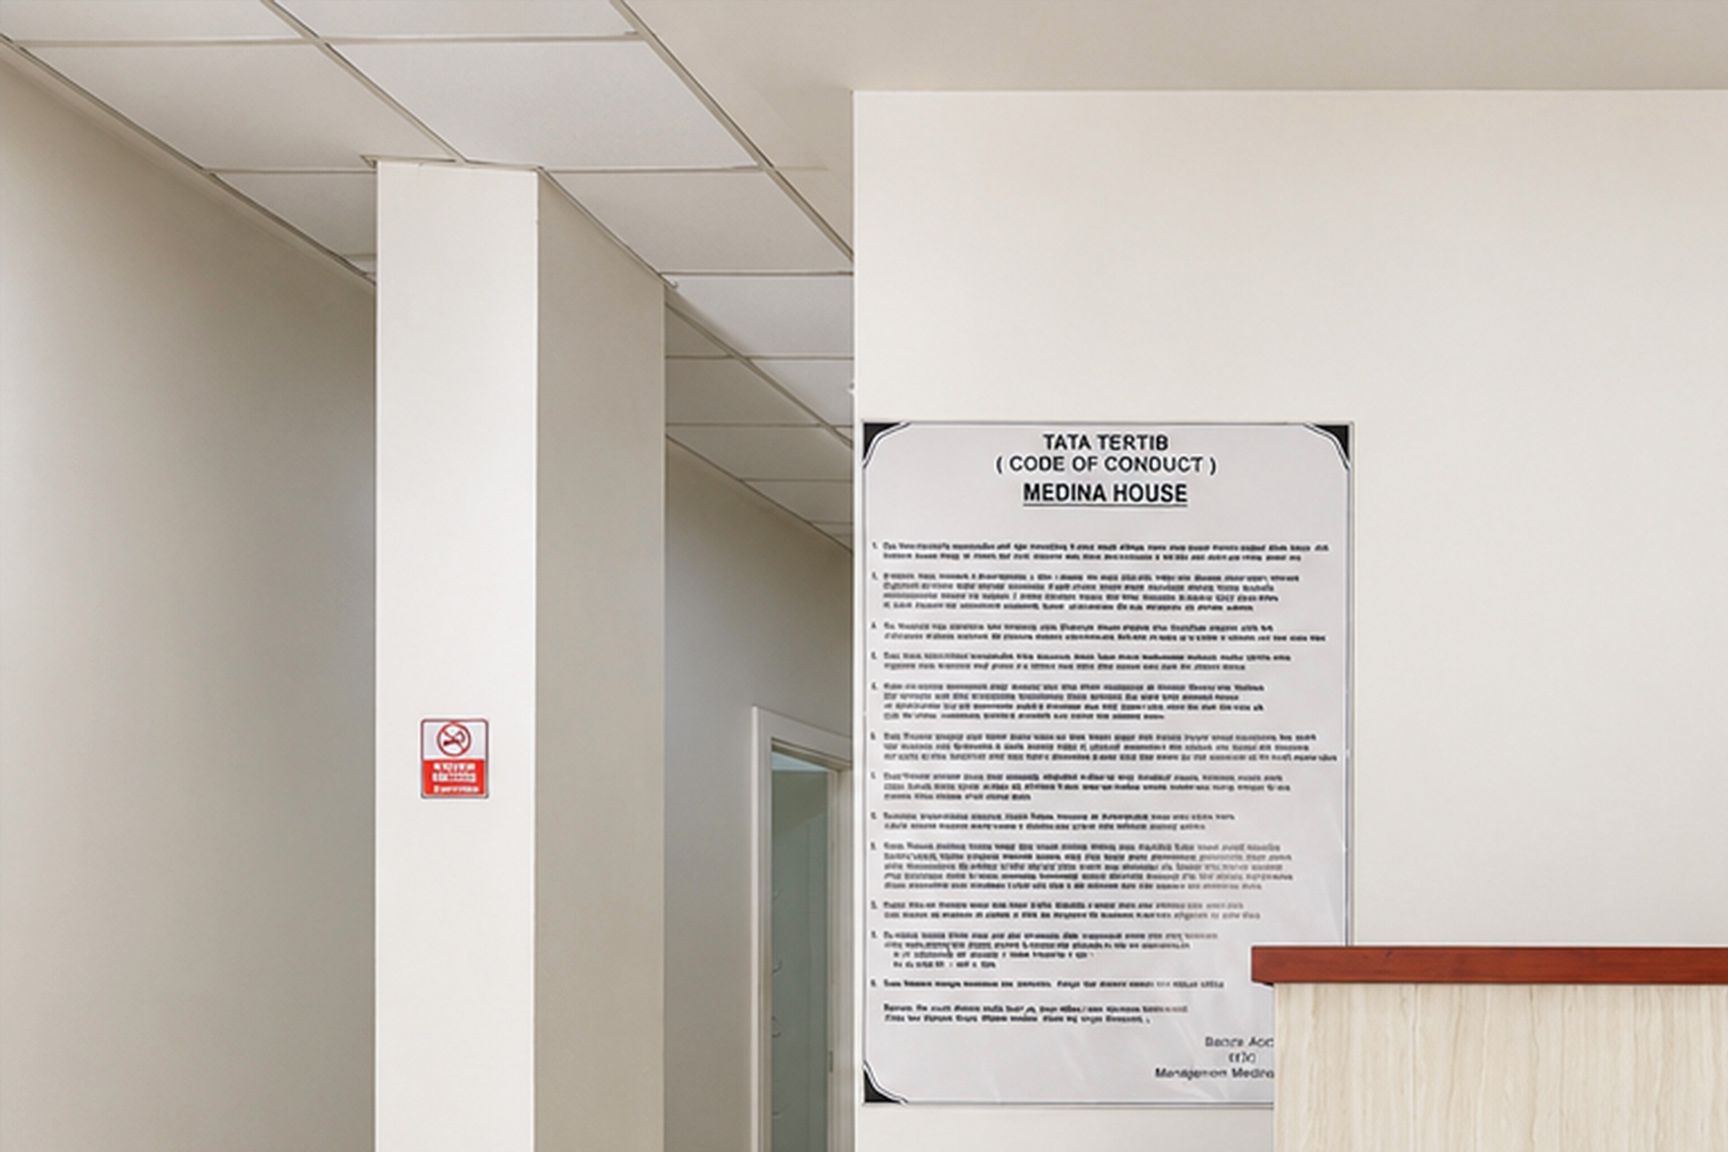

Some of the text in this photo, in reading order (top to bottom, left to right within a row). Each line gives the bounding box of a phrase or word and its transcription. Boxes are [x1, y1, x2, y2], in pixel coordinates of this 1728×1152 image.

[1043, 434, 1168, 450] TATA TERTIB
[1009, 456, 1065, 472] CODE
[1072, 456, 1098, 472] OF
[1104, 456, 1203, 473] CONDUCT
[1023, 483, 1188, 502] MEDINA HOUSE
